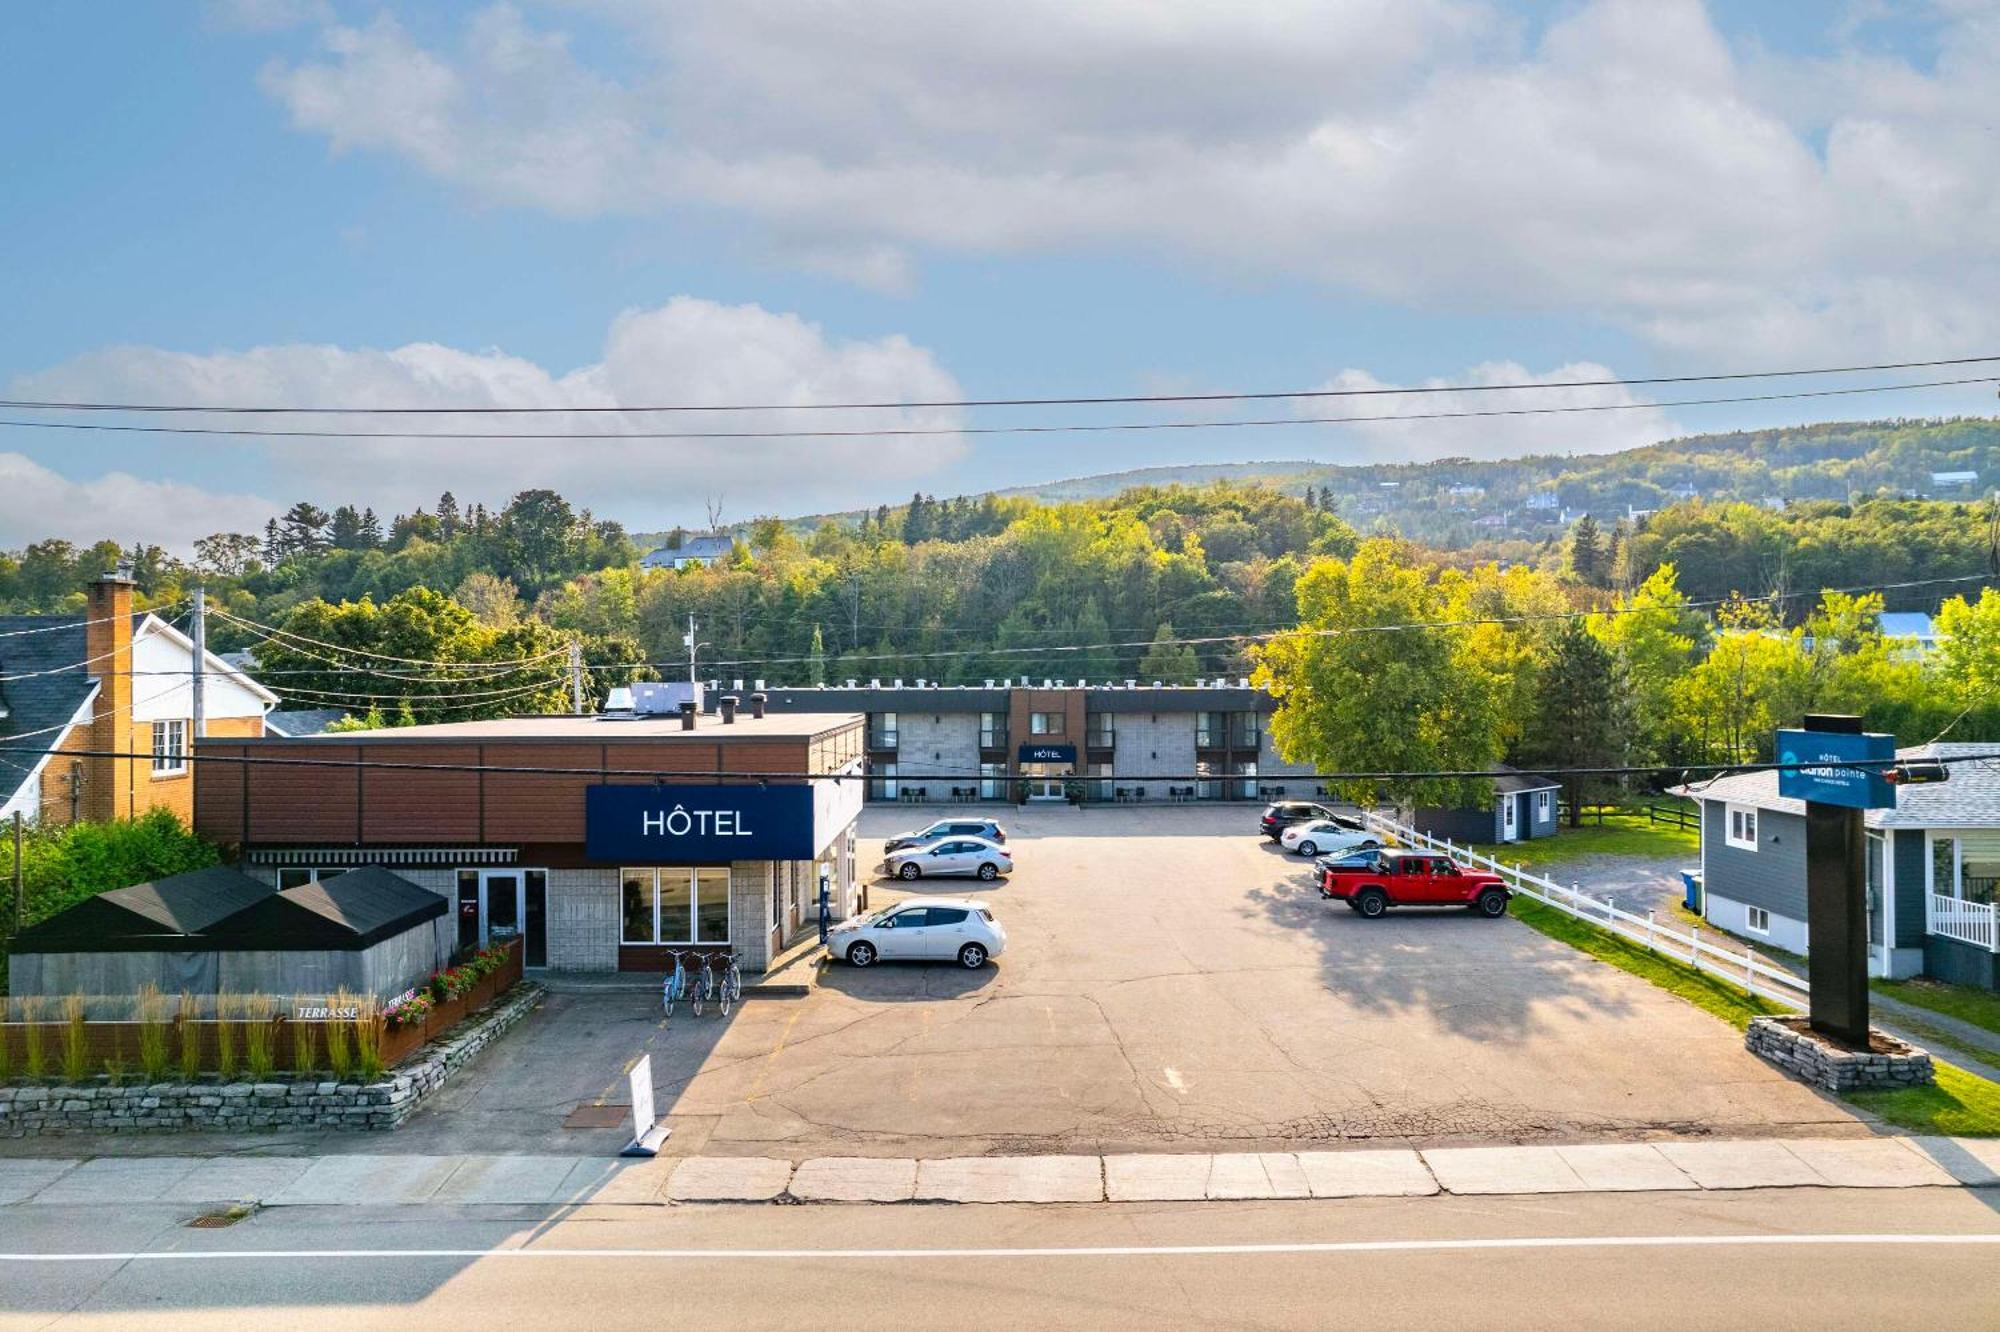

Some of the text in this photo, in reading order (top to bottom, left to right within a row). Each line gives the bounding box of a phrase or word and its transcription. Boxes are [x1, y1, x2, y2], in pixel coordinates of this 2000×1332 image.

[1034, 748, 1062, 758] HÔTEL
[1834, 767, 1866, 780] pointe
[643, 803, 753, 836] HÔTEL
[298, 1007, 358, 1018] TERRASSE
